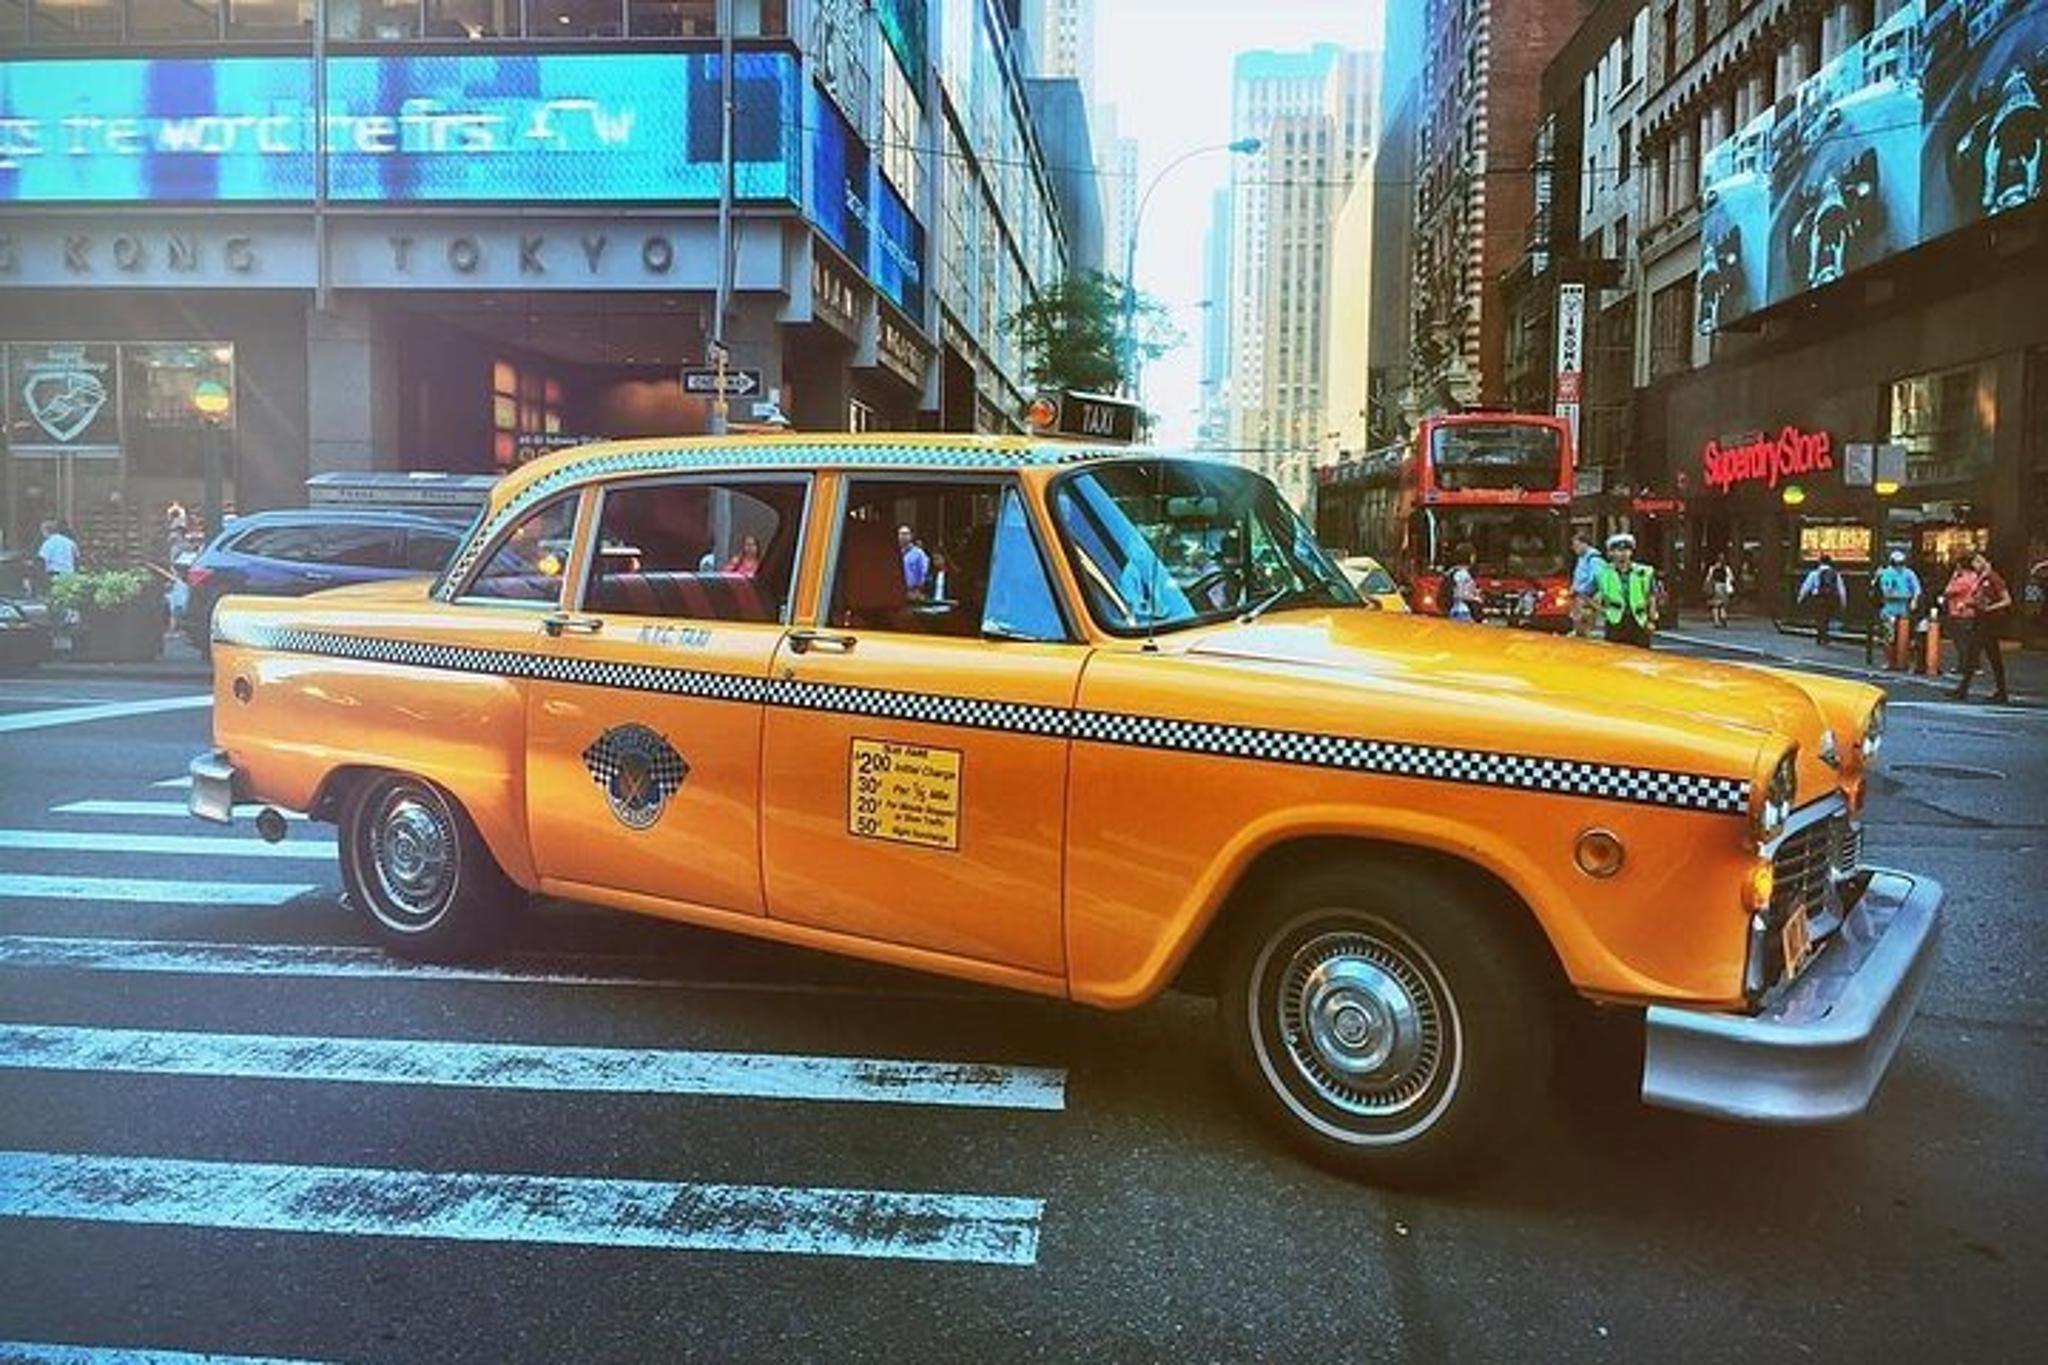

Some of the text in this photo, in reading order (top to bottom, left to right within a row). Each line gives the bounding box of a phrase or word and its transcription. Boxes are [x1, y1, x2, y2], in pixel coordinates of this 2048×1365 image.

[63, 232, 256, 274] KONG
[388, 233, 675, 275] TOKYO
[1082, 403, 1113, 434] TAXI
[680, 627, 712, 647] TAXI
